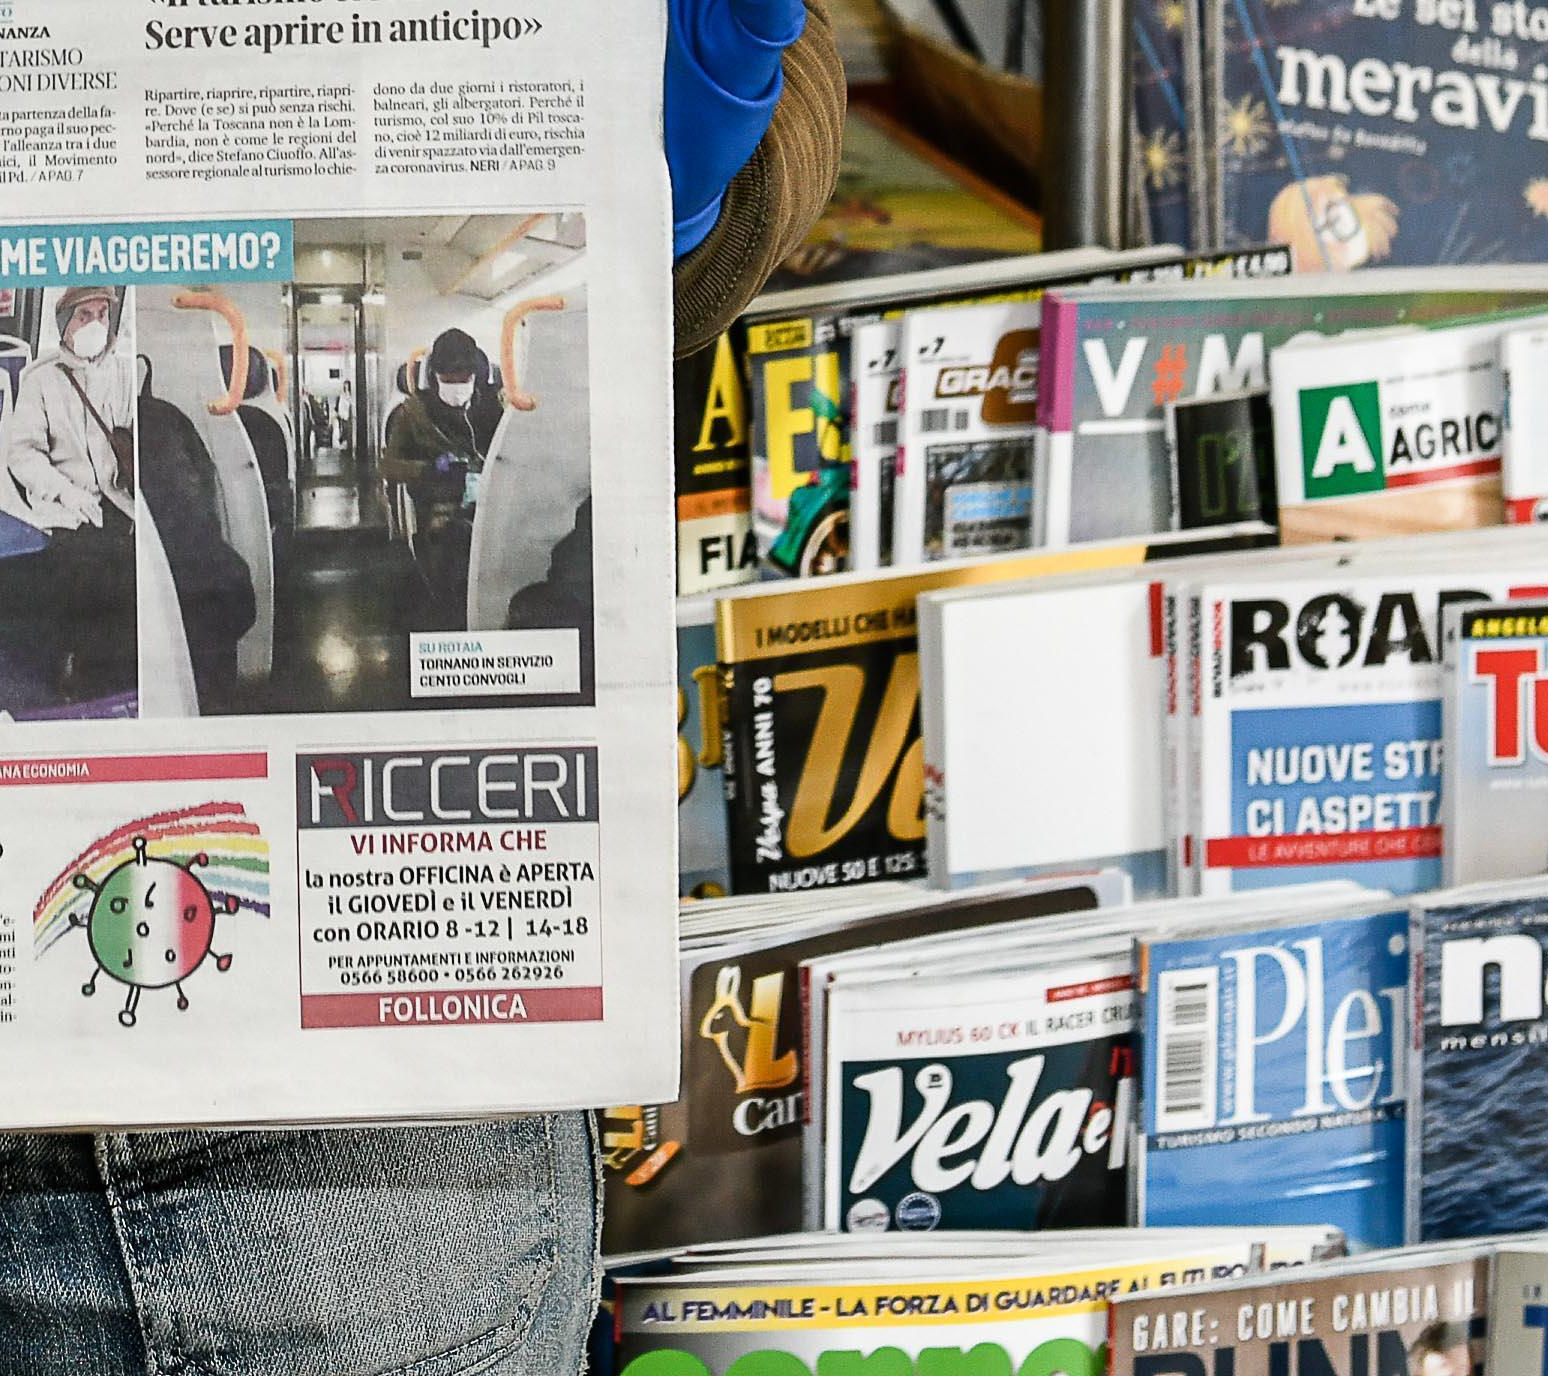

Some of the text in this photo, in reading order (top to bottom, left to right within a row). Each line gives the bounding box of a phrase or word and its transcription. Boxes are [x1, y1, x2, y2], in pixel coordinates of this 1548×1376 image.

[145, 10, 544, 54] Serve aprire in anticipo»
[53, 230, 282, 276] VIAGGEREMO?
[1247, 743, 1373, 786] NUOVE
[309, 753, 588, 823] RICCERI
[349, 829, 548, 855] VI INFORMA CHE
[378, 994, 528, 1023] FOLLONICA
[848, 1054, 1084, 1196] Vela
[1131, 1284, 1444, 1352] GARE: COME CAMBIA
